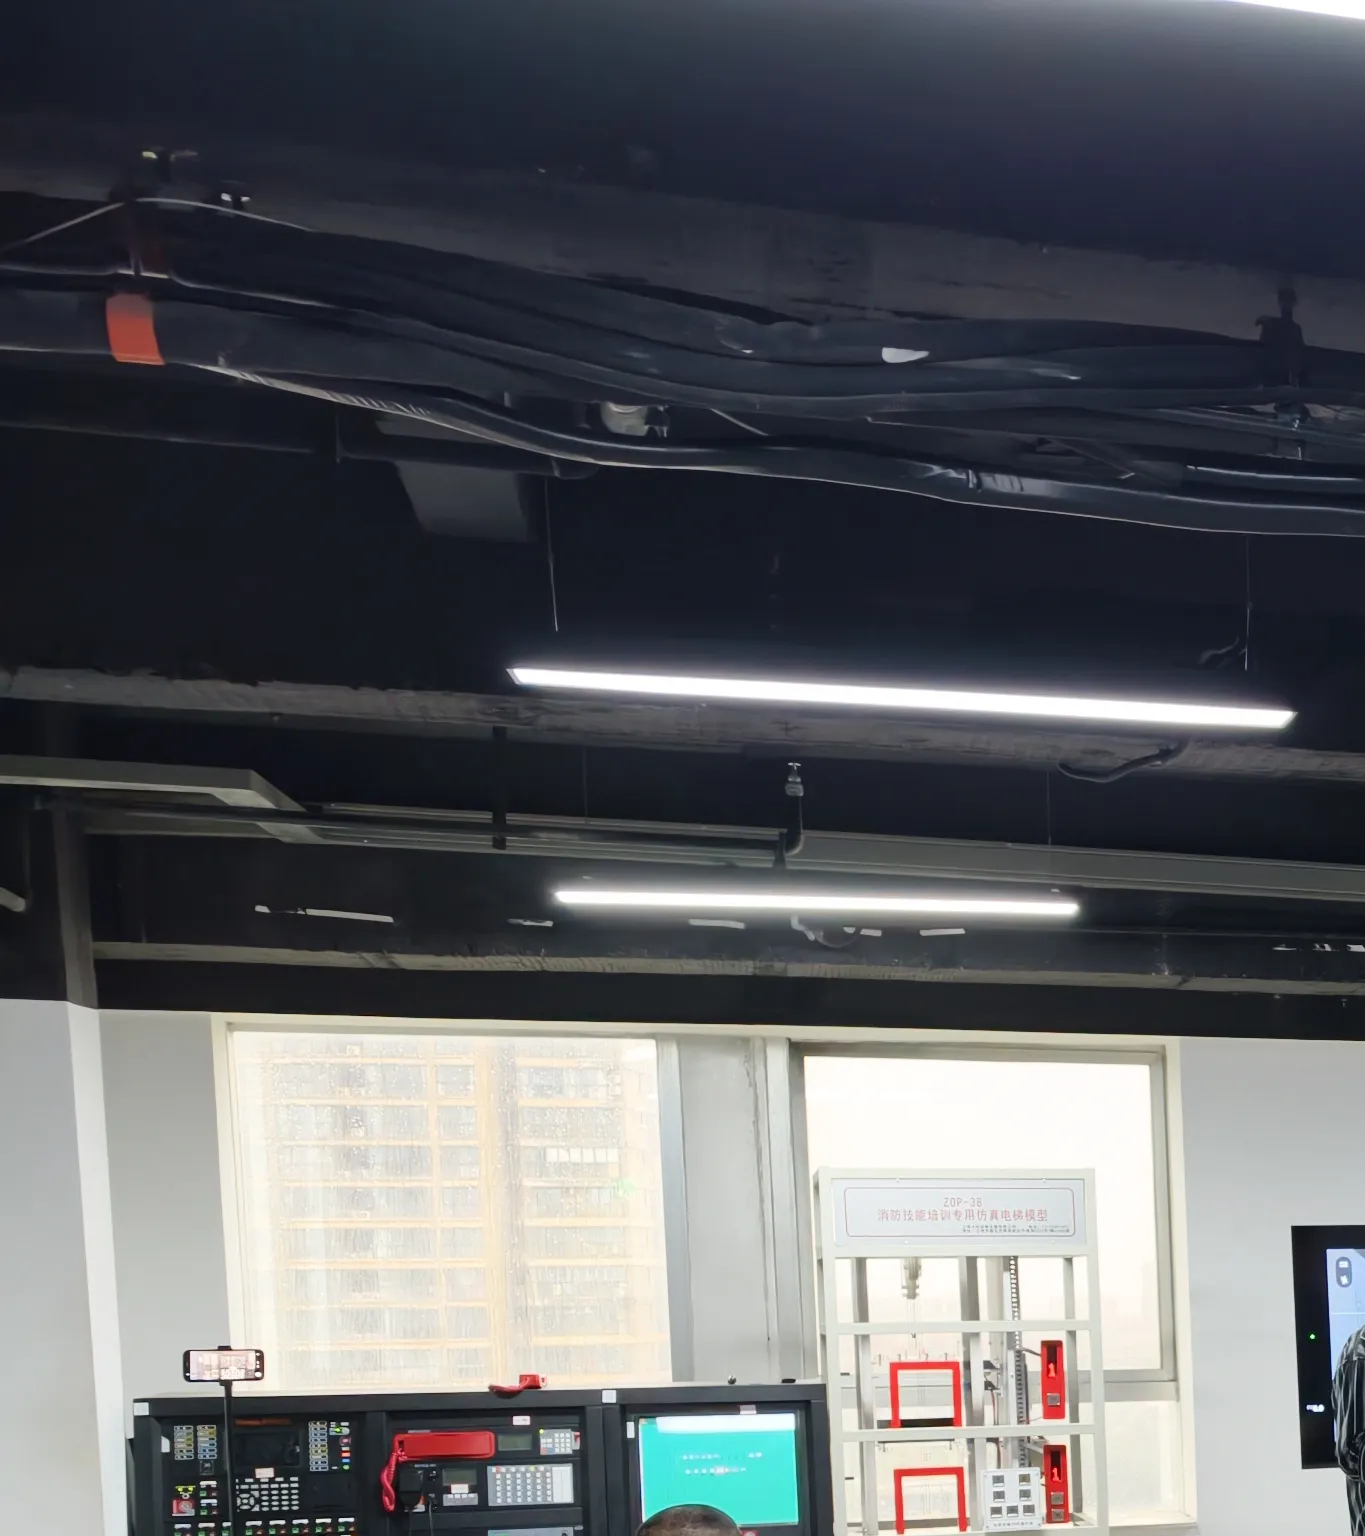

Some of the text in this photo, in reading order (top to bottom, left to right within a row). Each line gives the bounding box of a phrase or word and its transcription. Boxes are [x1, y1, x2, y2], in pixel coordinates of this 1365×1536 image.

[877, 1209, 1048, 1222] 消防技能培训专用仿真电梯模型
